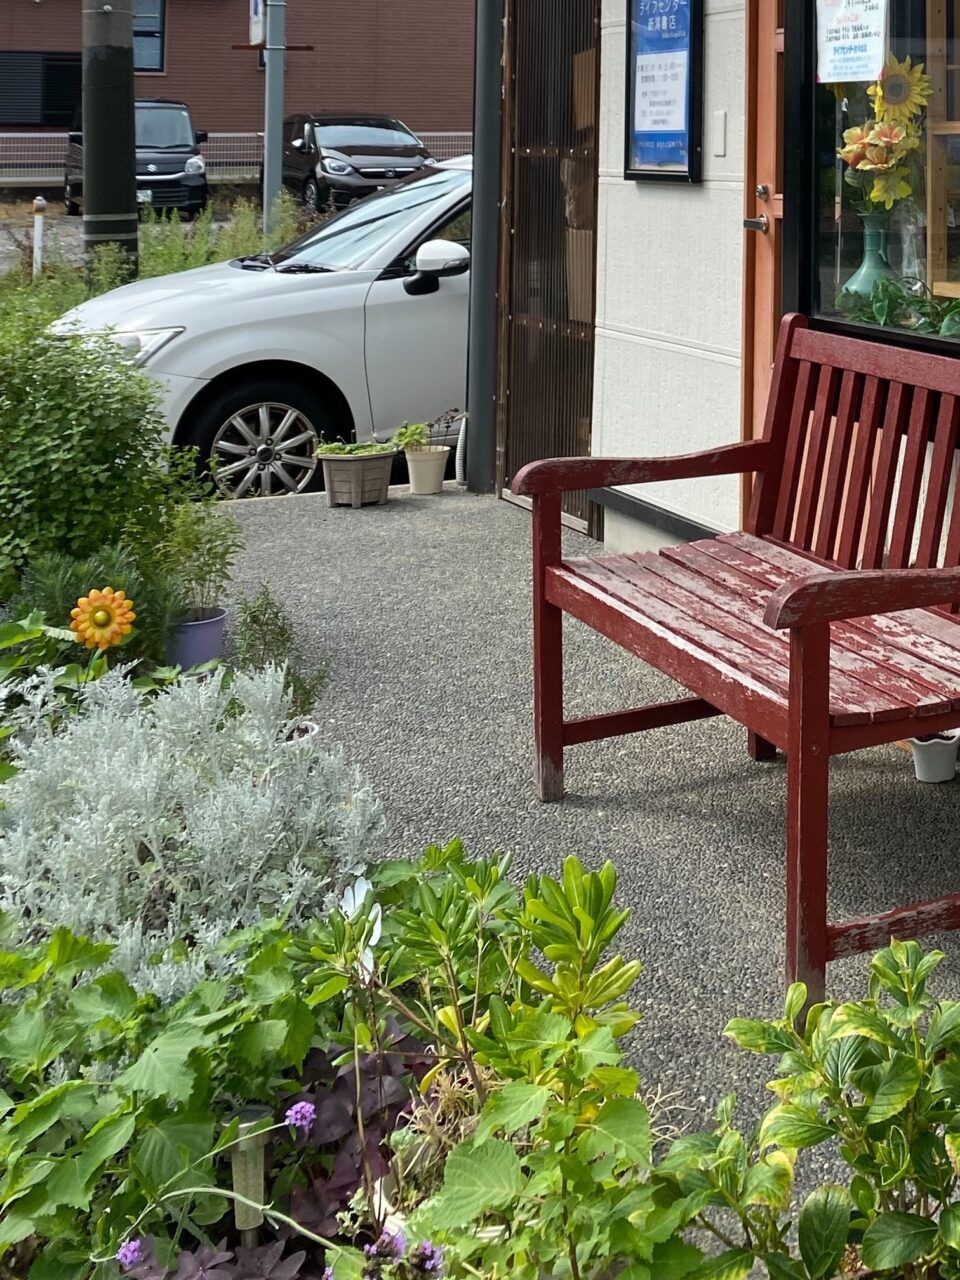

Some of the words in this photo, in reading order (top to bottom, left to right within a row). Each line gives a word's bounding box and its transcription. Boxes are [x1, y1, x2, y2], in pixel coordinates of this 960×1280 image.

[640, 0, 687, 16] ライフセンター
